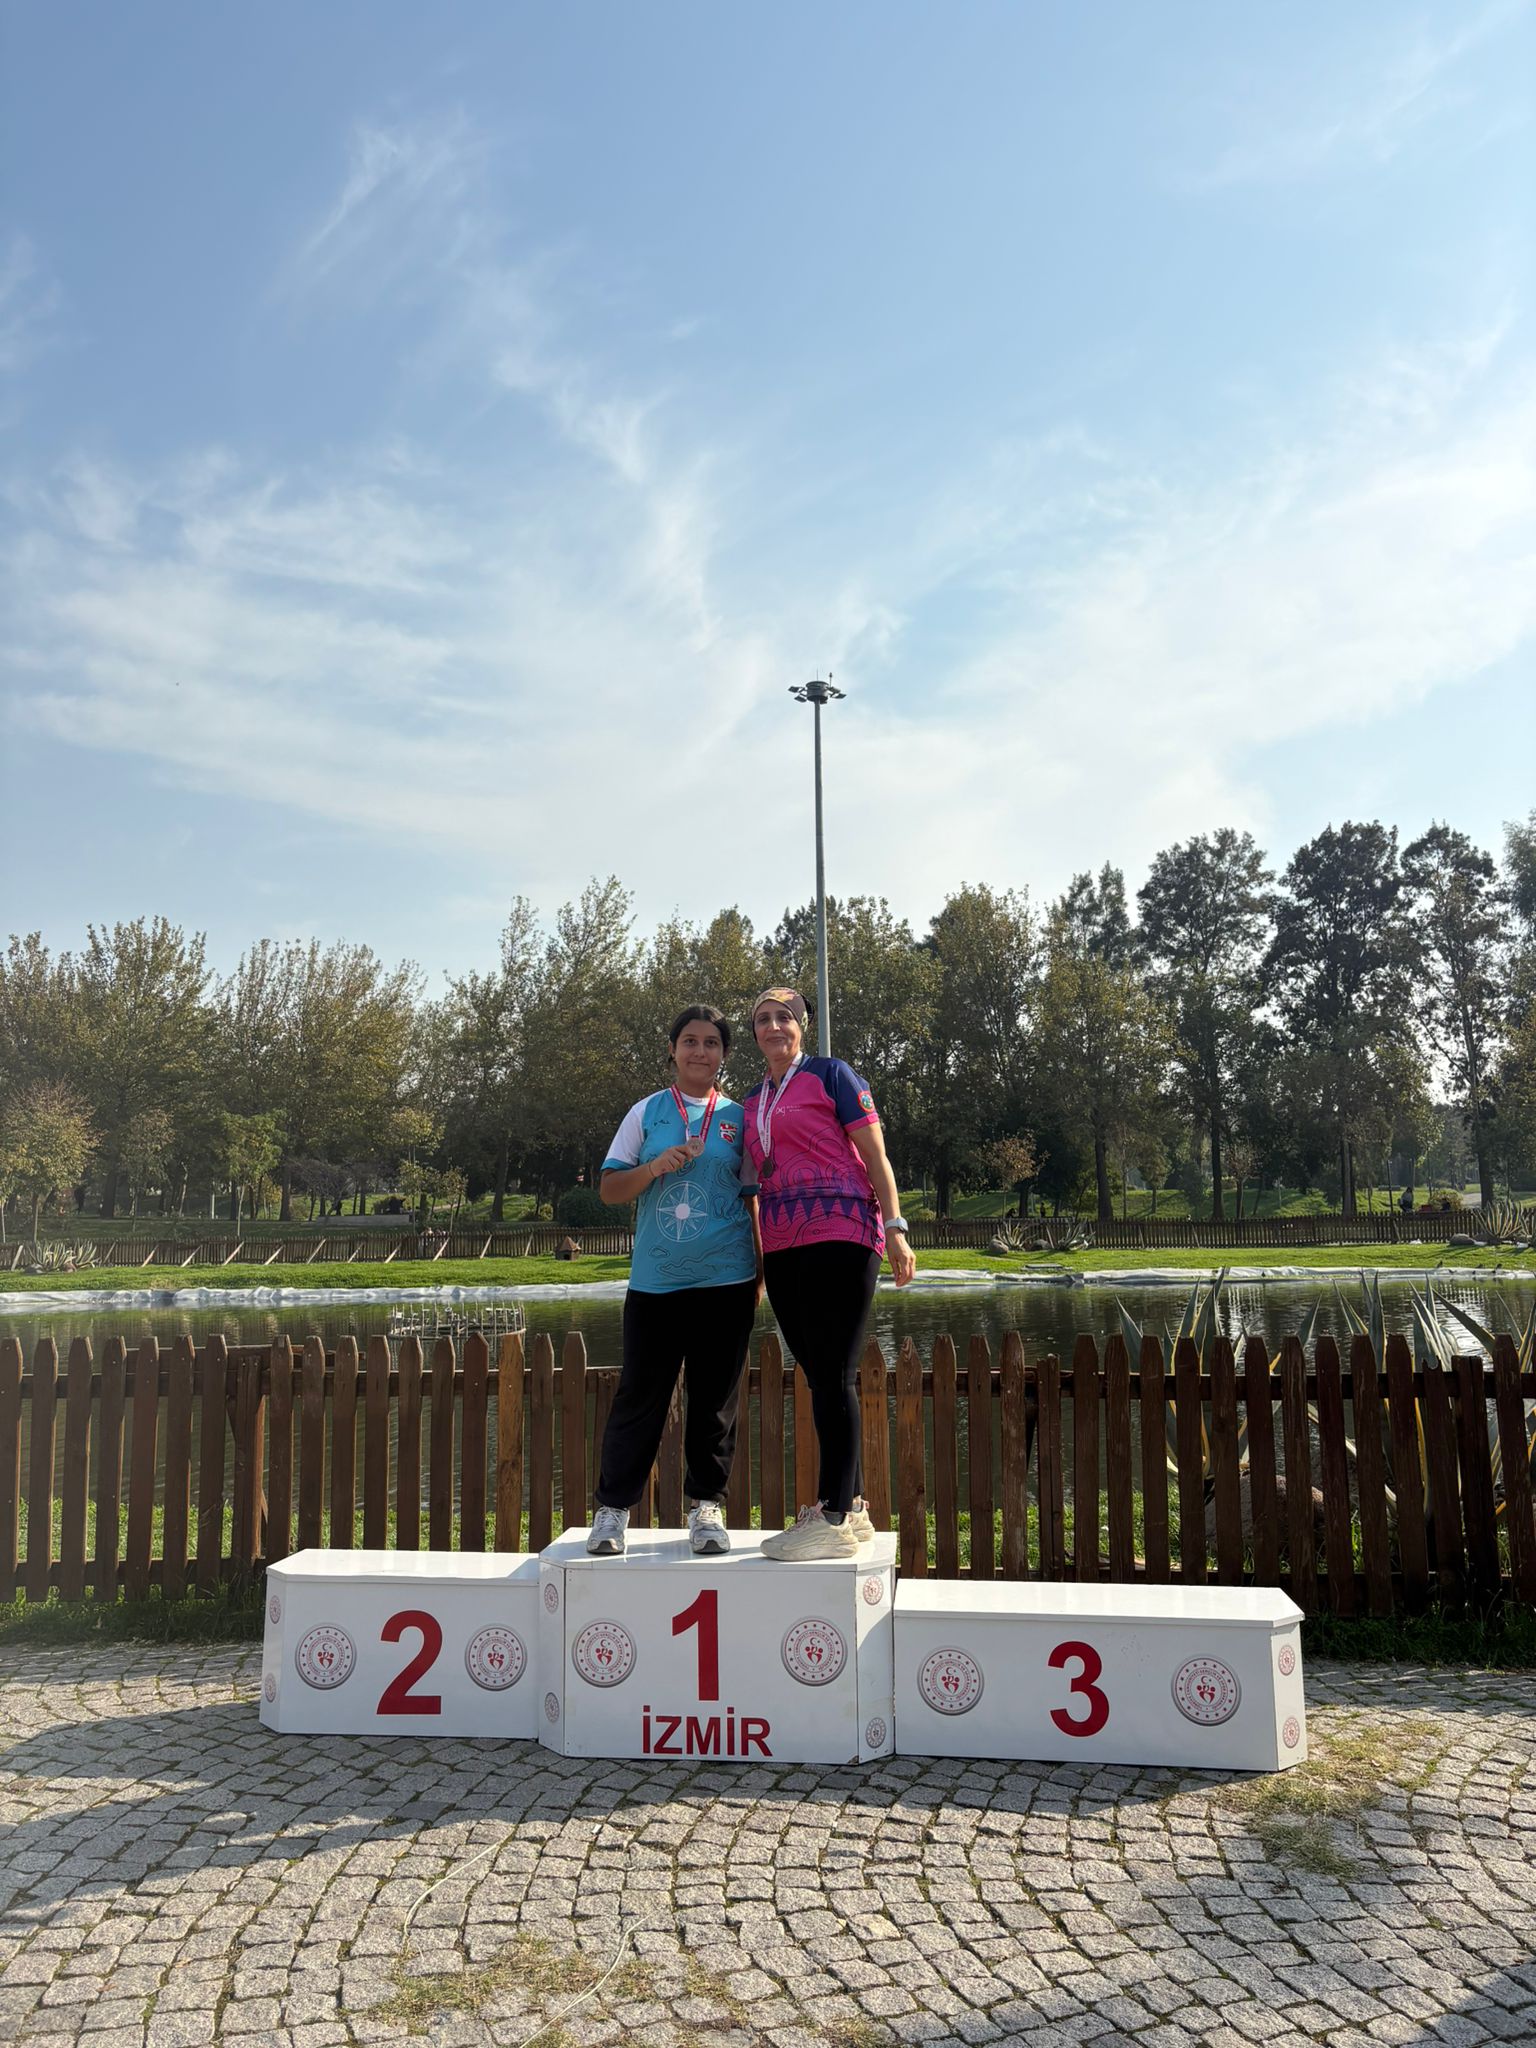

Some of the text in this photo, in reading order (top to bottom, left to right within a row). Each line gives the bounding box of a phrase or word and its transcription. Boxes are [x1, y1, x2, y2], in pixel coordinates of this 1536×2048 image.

[377, 1609, 443, 1715] 2
[671, 1590, 719, 1701] 1
[1047, 1641, 1110, 1737] 3
[643, 1705, 773, 1757] İZMİR
